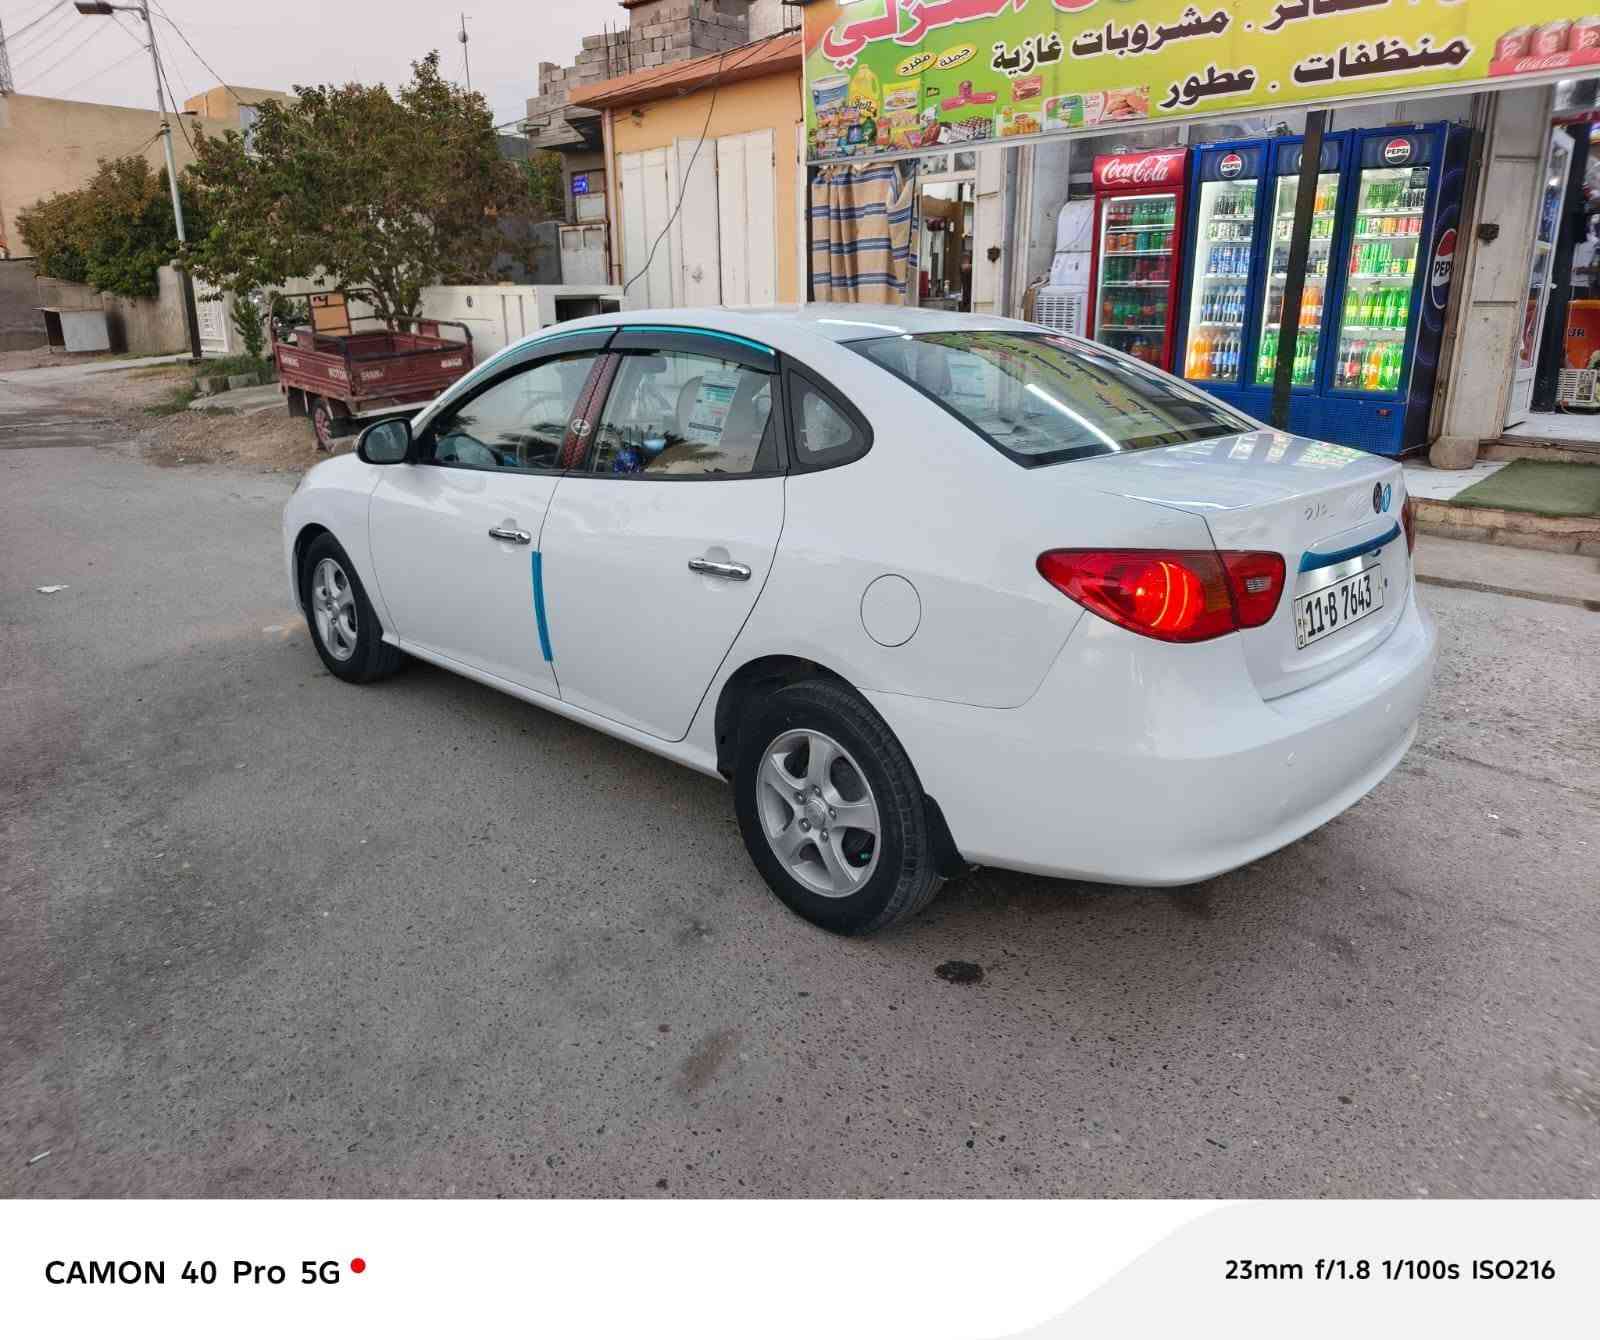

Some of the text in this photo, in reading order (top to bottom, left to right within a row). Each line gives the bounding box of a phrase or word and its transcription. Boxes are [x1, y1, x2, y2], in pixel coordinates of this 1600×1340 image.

[1073, 8, 1228, 56] مشروبات
[993, 35, 1062, 75] غازية
[1294, 38, 1469, 83] منظفات
[1160, 66, 1255, 108] عطور
[1341, 575, 1371, 620] 7643
